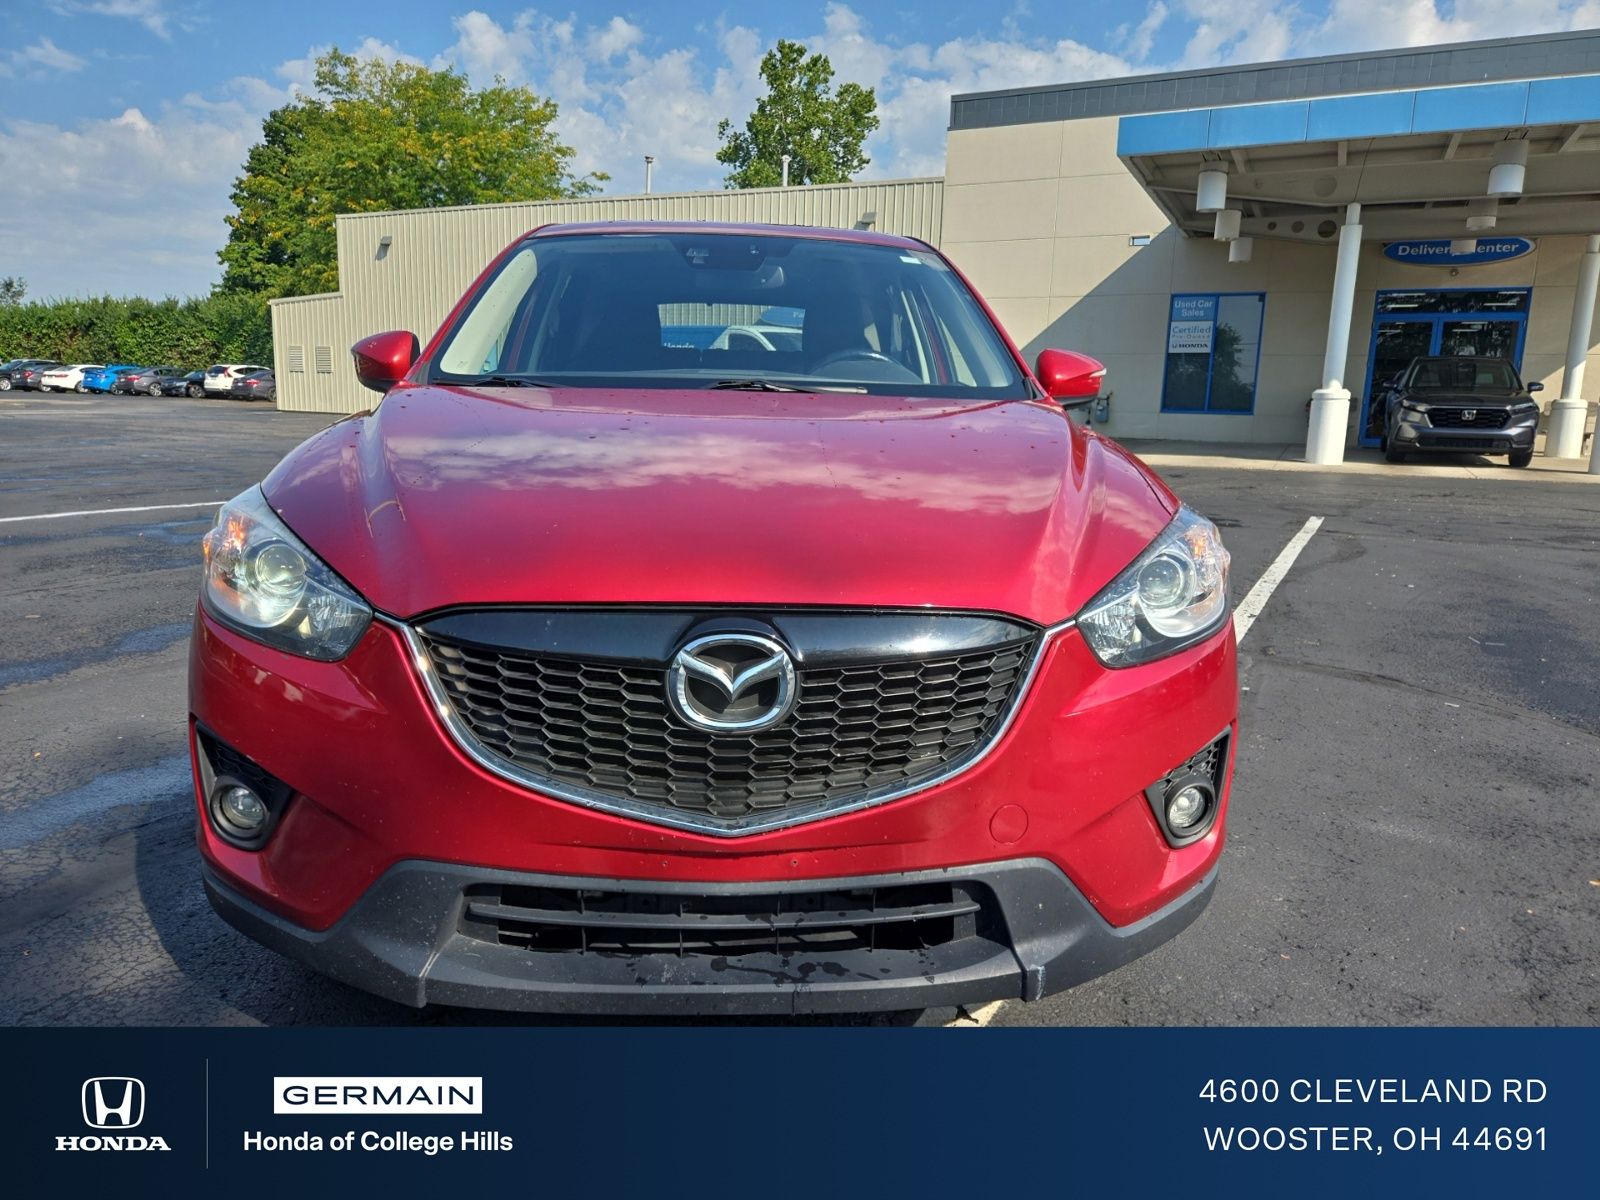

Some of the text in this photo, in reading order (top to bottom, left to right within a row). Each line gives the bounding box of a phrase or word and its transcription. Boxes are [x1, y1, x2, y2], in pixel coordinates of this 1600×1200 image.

[1398, 243, 1519, 256] Deliver enter
[1174, 298, 1212, 308] Used Car
[1181, 308, 1204, 317] Sales
[1172, 324, 1211, 334] Certified
